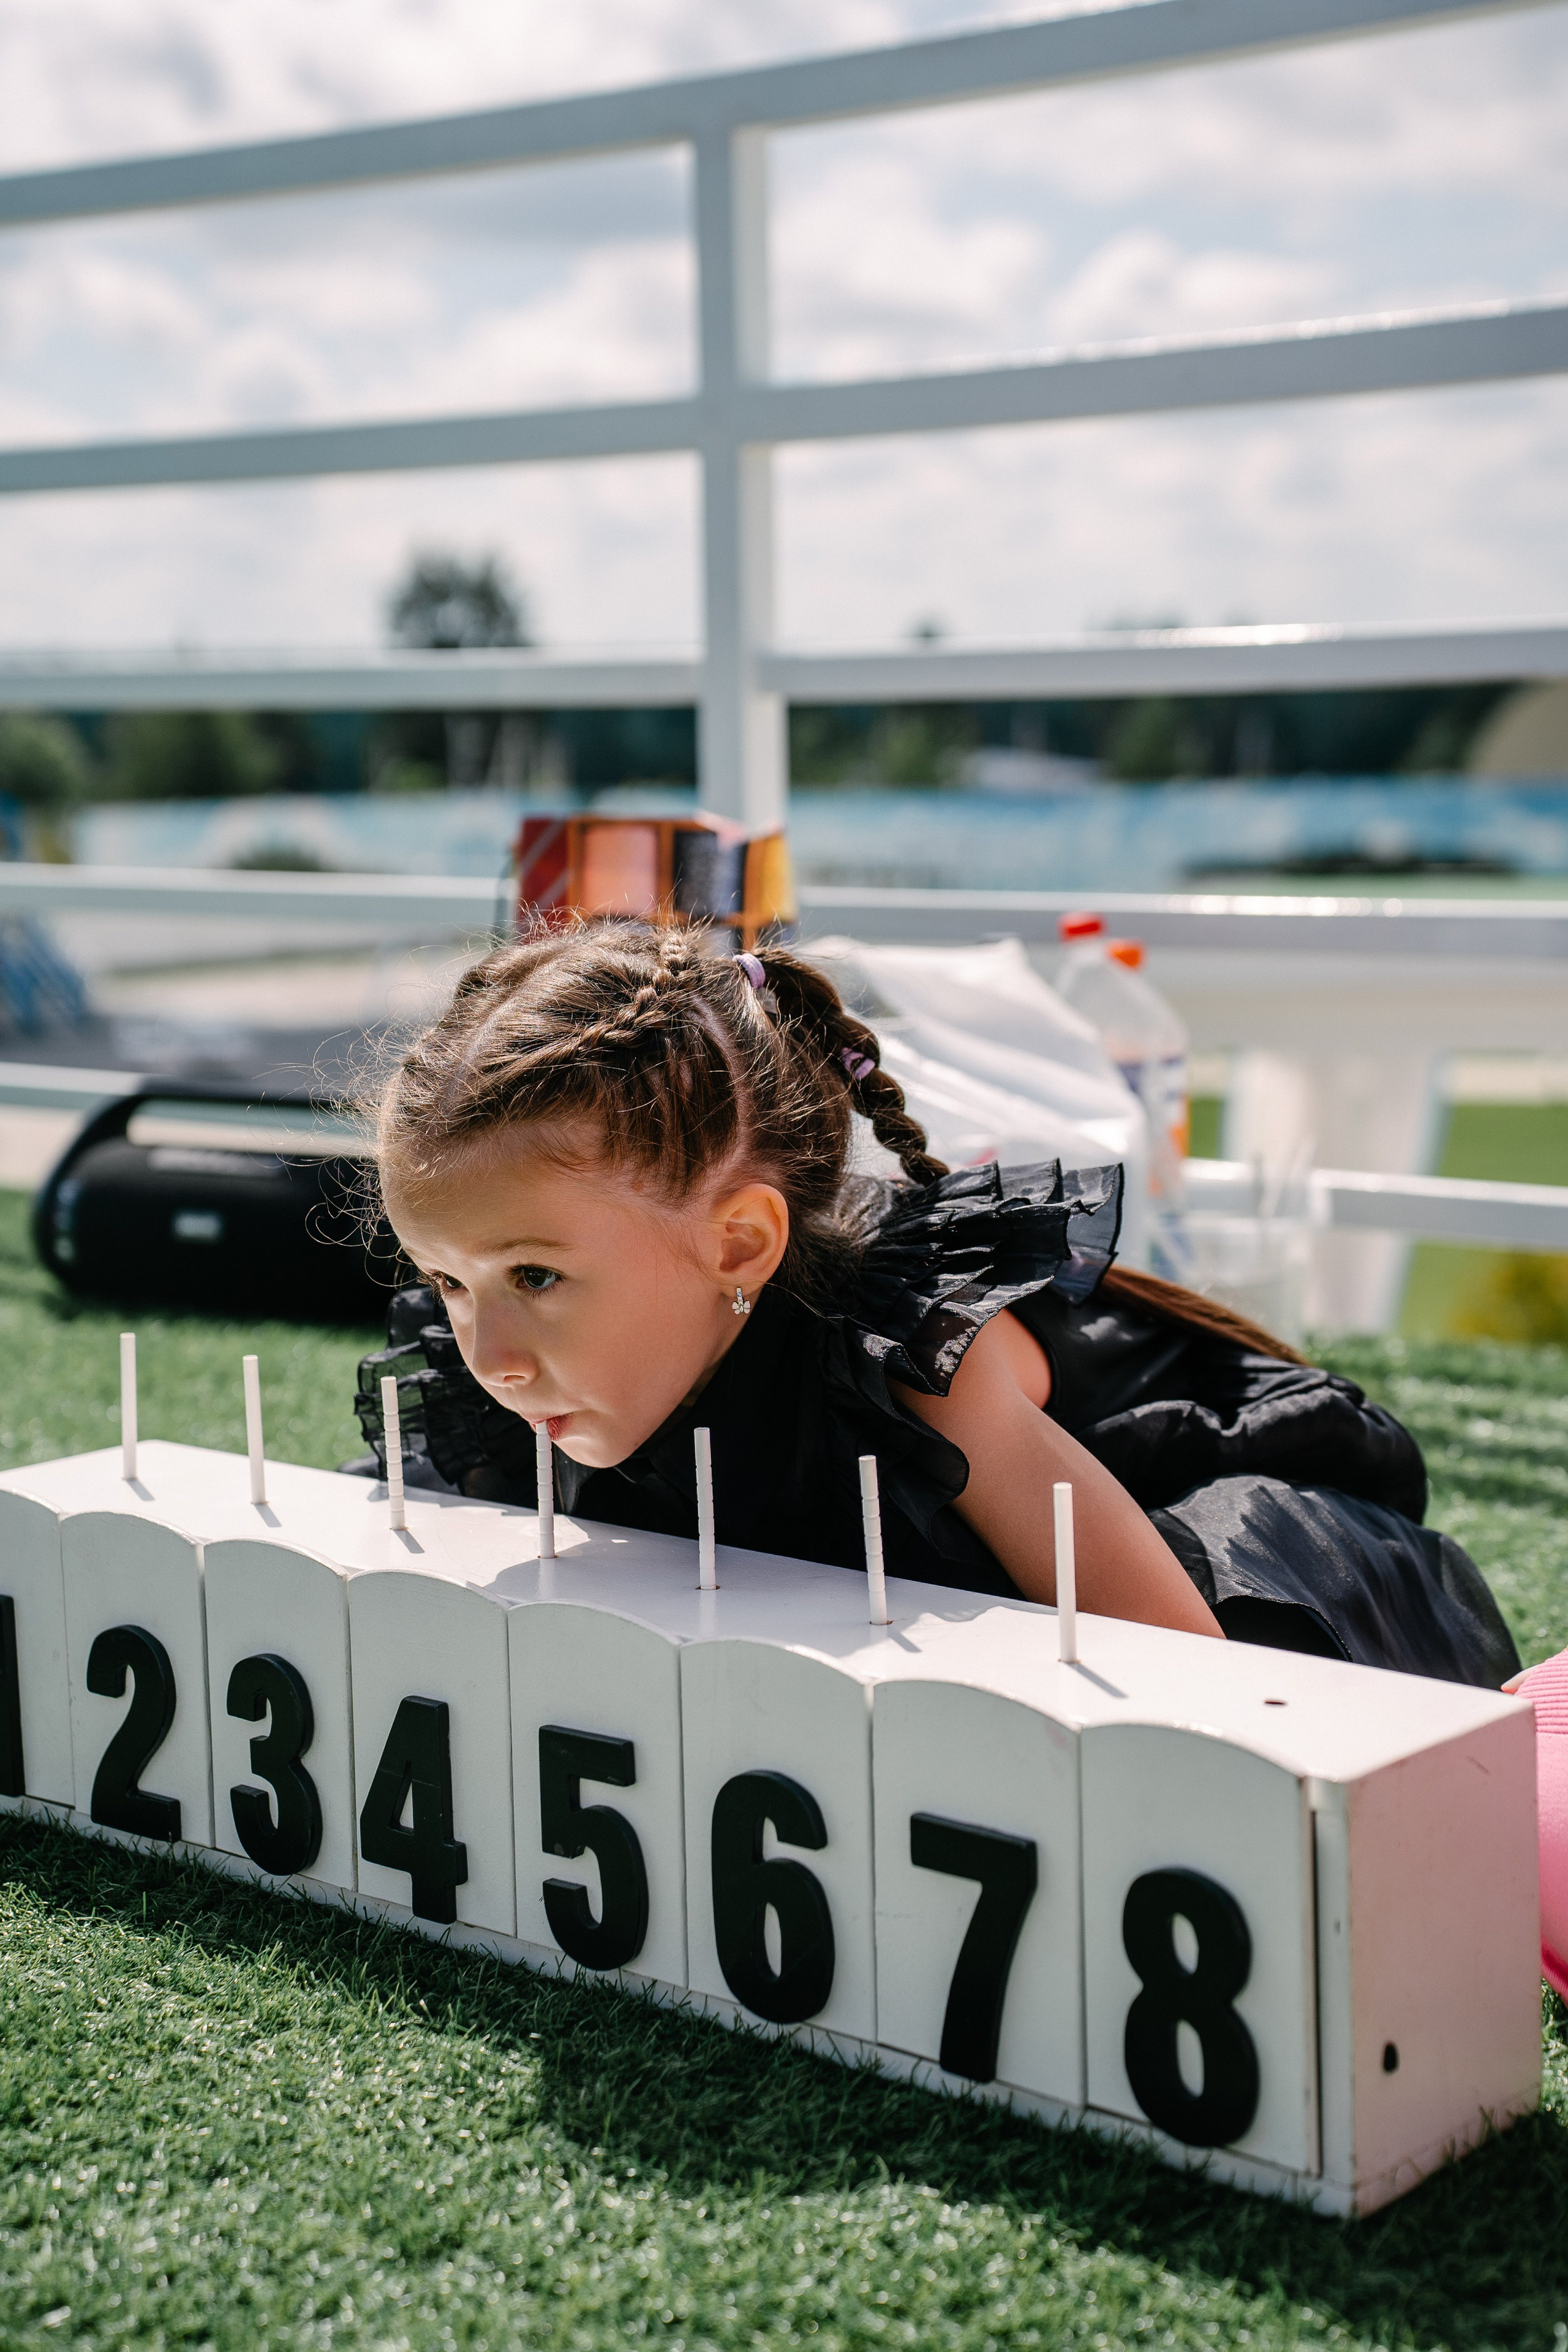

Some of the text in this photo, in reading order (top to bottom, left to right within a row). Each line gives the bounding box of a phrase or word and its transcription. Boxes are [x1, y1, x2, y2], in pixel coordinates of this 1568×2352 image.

[87, 1626, 181, 1842] 2
[227, 1654, 322, 1875] 3
[360, 1696, 467, 1924] 4
[539, 1725, 649, 1970] 5
[712, 1770, 835, 2024] 6
[910, 1813, 1038, 2083] 7
[1123, 1867, 1260, 2146] 8
